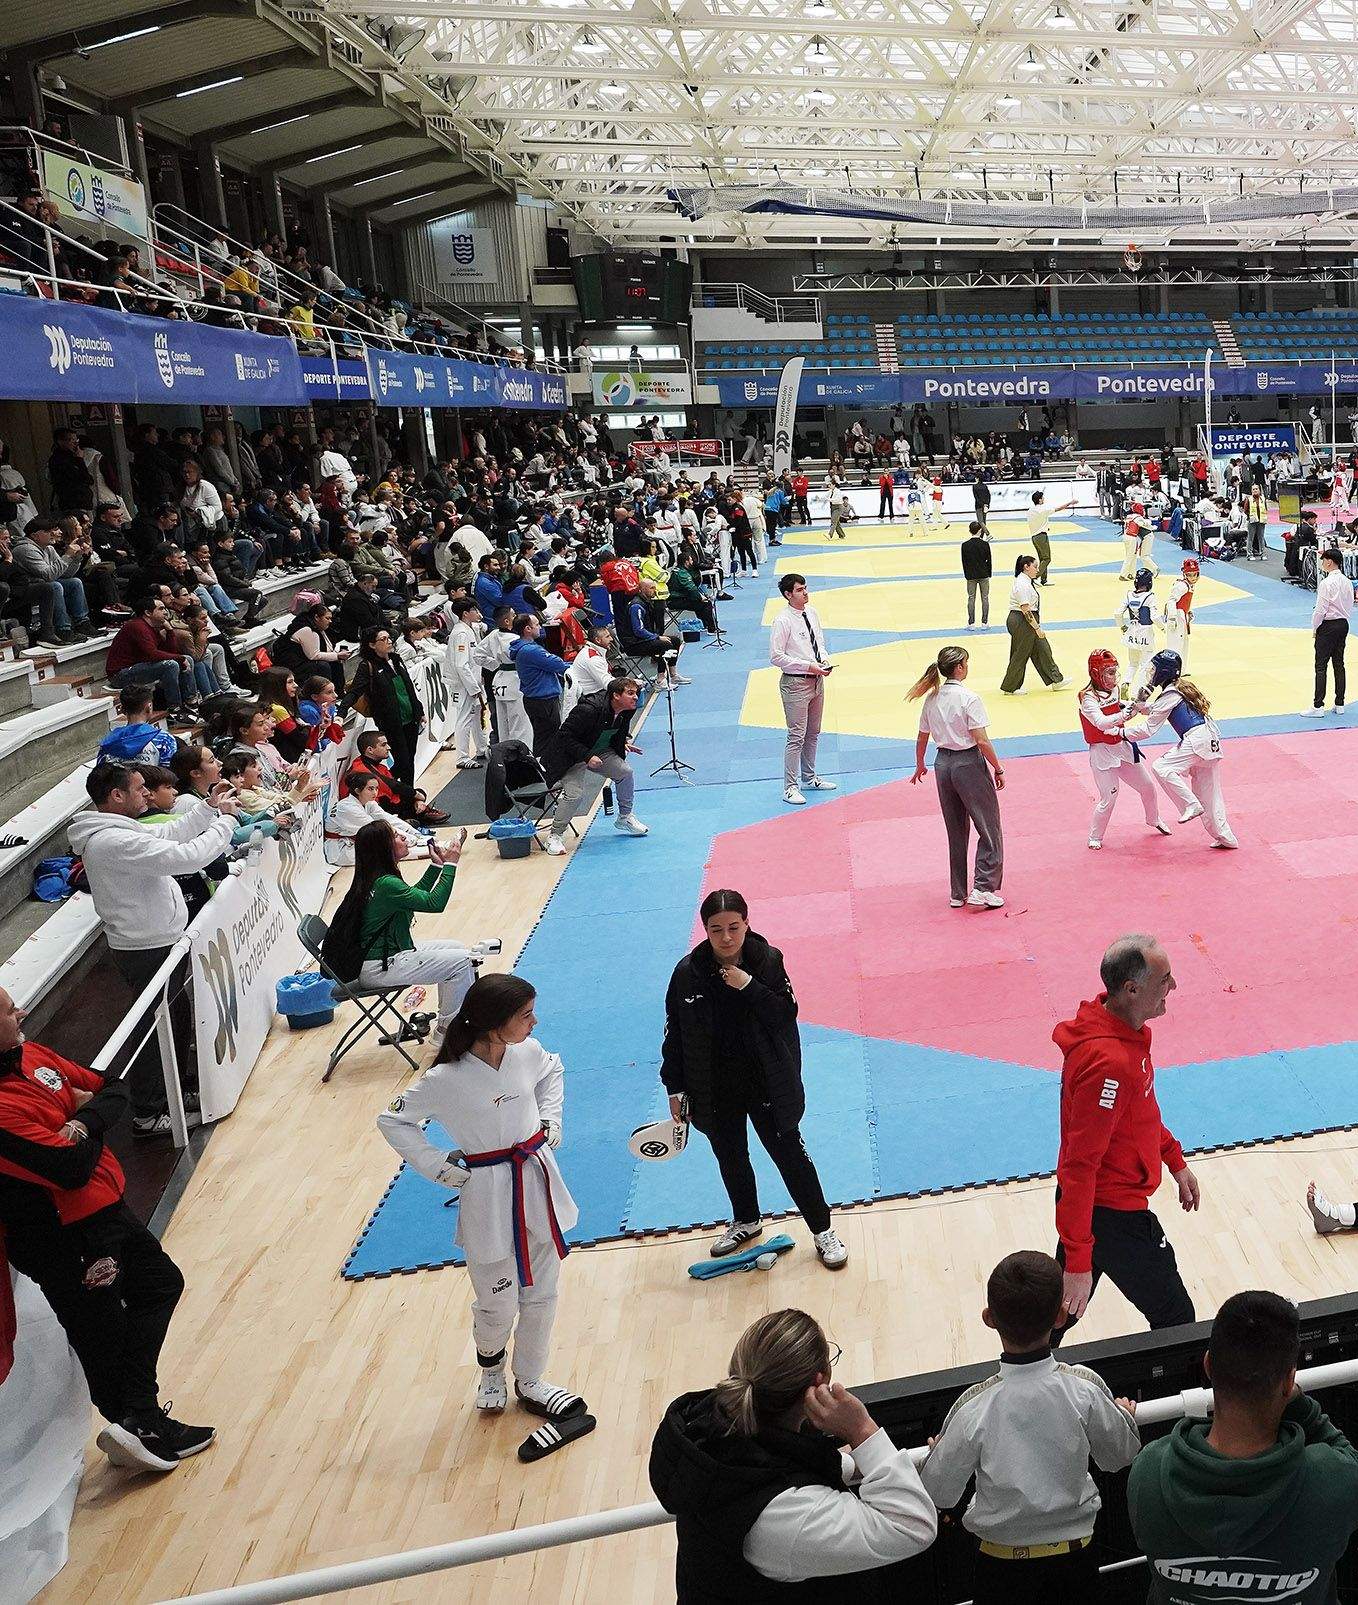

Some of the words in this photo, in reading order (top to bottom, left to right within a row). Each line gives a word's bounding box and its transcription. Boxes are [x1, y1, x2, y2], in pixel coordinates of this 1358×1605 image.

[70, 333, 113, 352] Deputación
[72, 350, 115, 368] Pontevedra
[170, 349, 192, 363] Concello
[303, 372, 332, 385] DEPORTE
[924, 376, 1050, 397] Pontevedra
[1097, 372, 1216, 394] Pontevedra
[778, 384, 789, 428] Deputación
[1211, 440, 1290, 450] ONTEVEDRA
[1218, 433, 1276, 442] DEPORTE
[238, 910, 285, 996] Pontevedra
[1098, 1077, 1119, 1110] ABU
[491, 1279, 513, 1295] Daedo
[1158, 1564, 1318, 1592] CHAOTIC
